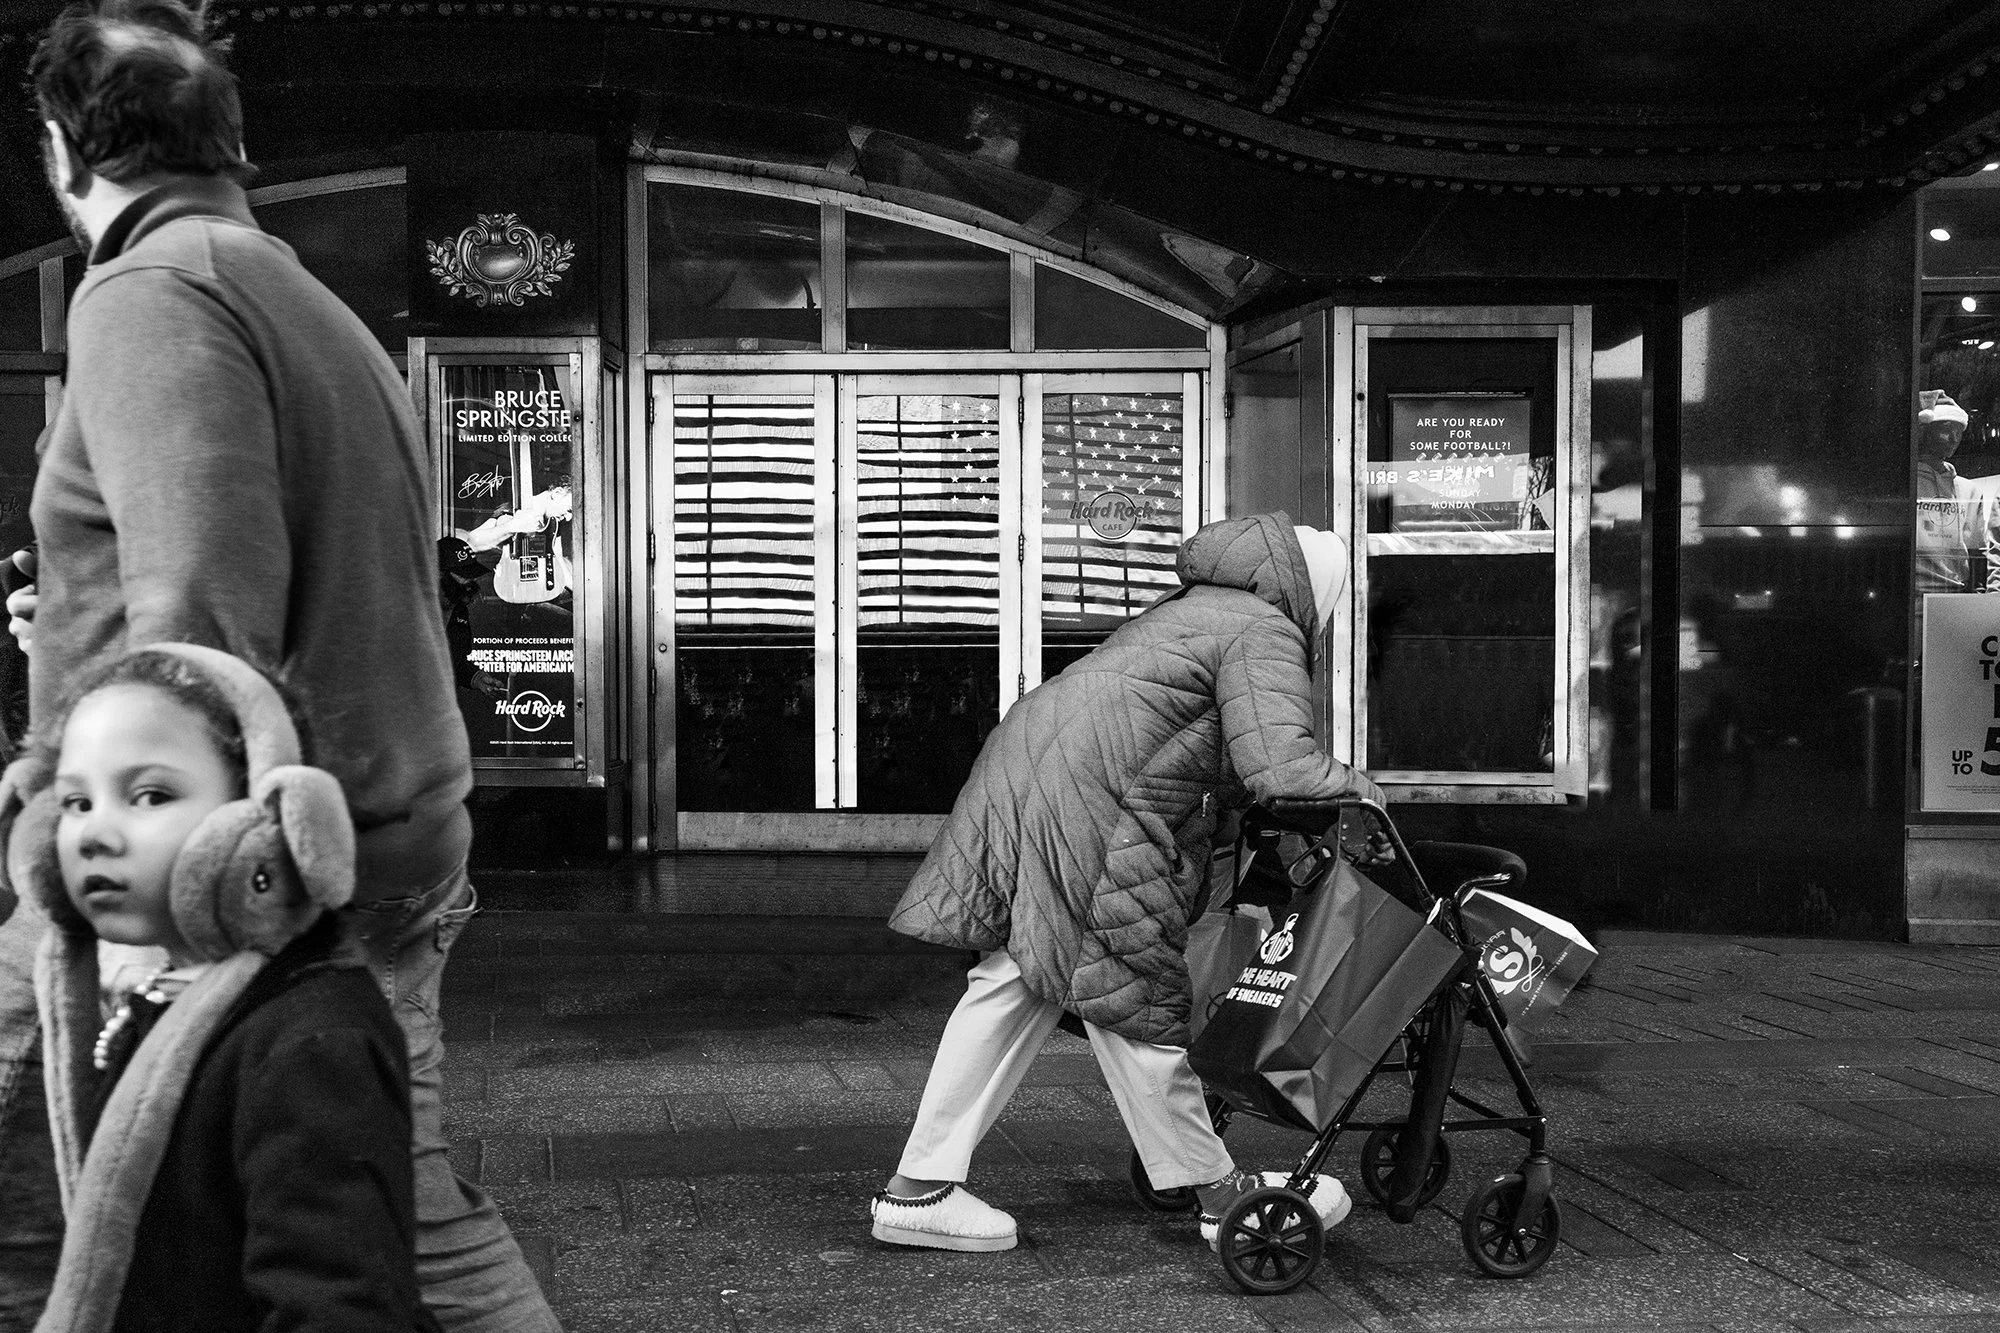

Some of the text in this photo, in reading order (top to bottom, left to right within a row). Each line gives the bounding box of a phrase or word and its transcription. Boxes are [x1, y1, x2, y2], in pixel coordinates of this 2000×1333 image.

[495, 390, 561, 408] BRUCE
[456, 409, 571, 428] SPRINGSTE
[1416, 418, 1505, 427] ARE YOU READY
[458, 434, 494, 443] LIMITED
[498, 434, 536, 443] EDITION
[1450, 430, 1472, 439] FOR
[1410, 442, 1511, 451] SOME FOOTBALL?!
[1439, 488, 1482, 497] SUNDAY
[1431, 500, 1477, 509] MONDAY
[1070, 501, 1155, 521] Hard Rock
[1102, 523, 1124, 531] CAFE
[473, 637, 503, 645] PORTION
[504, 637, 514, 645] OF
[515, 637, 548, 645] PROCEEDS
[494, 649, 552, 662] SPRINGSTEEN
[474, 661, 505, 673] ENTER
[506, 661, 523, 673] FOR
[523, 661, 567, 673] AMERICAN
[1979, 659, 2000, 681] T
[495, 700, 566, 718] Hard Rock
[1952, 750, 1973, 762] UP
[1952, 763, 1973, 775] TO
[1236, 967, 1298, 991] HE HEART
[1236, 988, 1285, 1008] SNEAKERS
